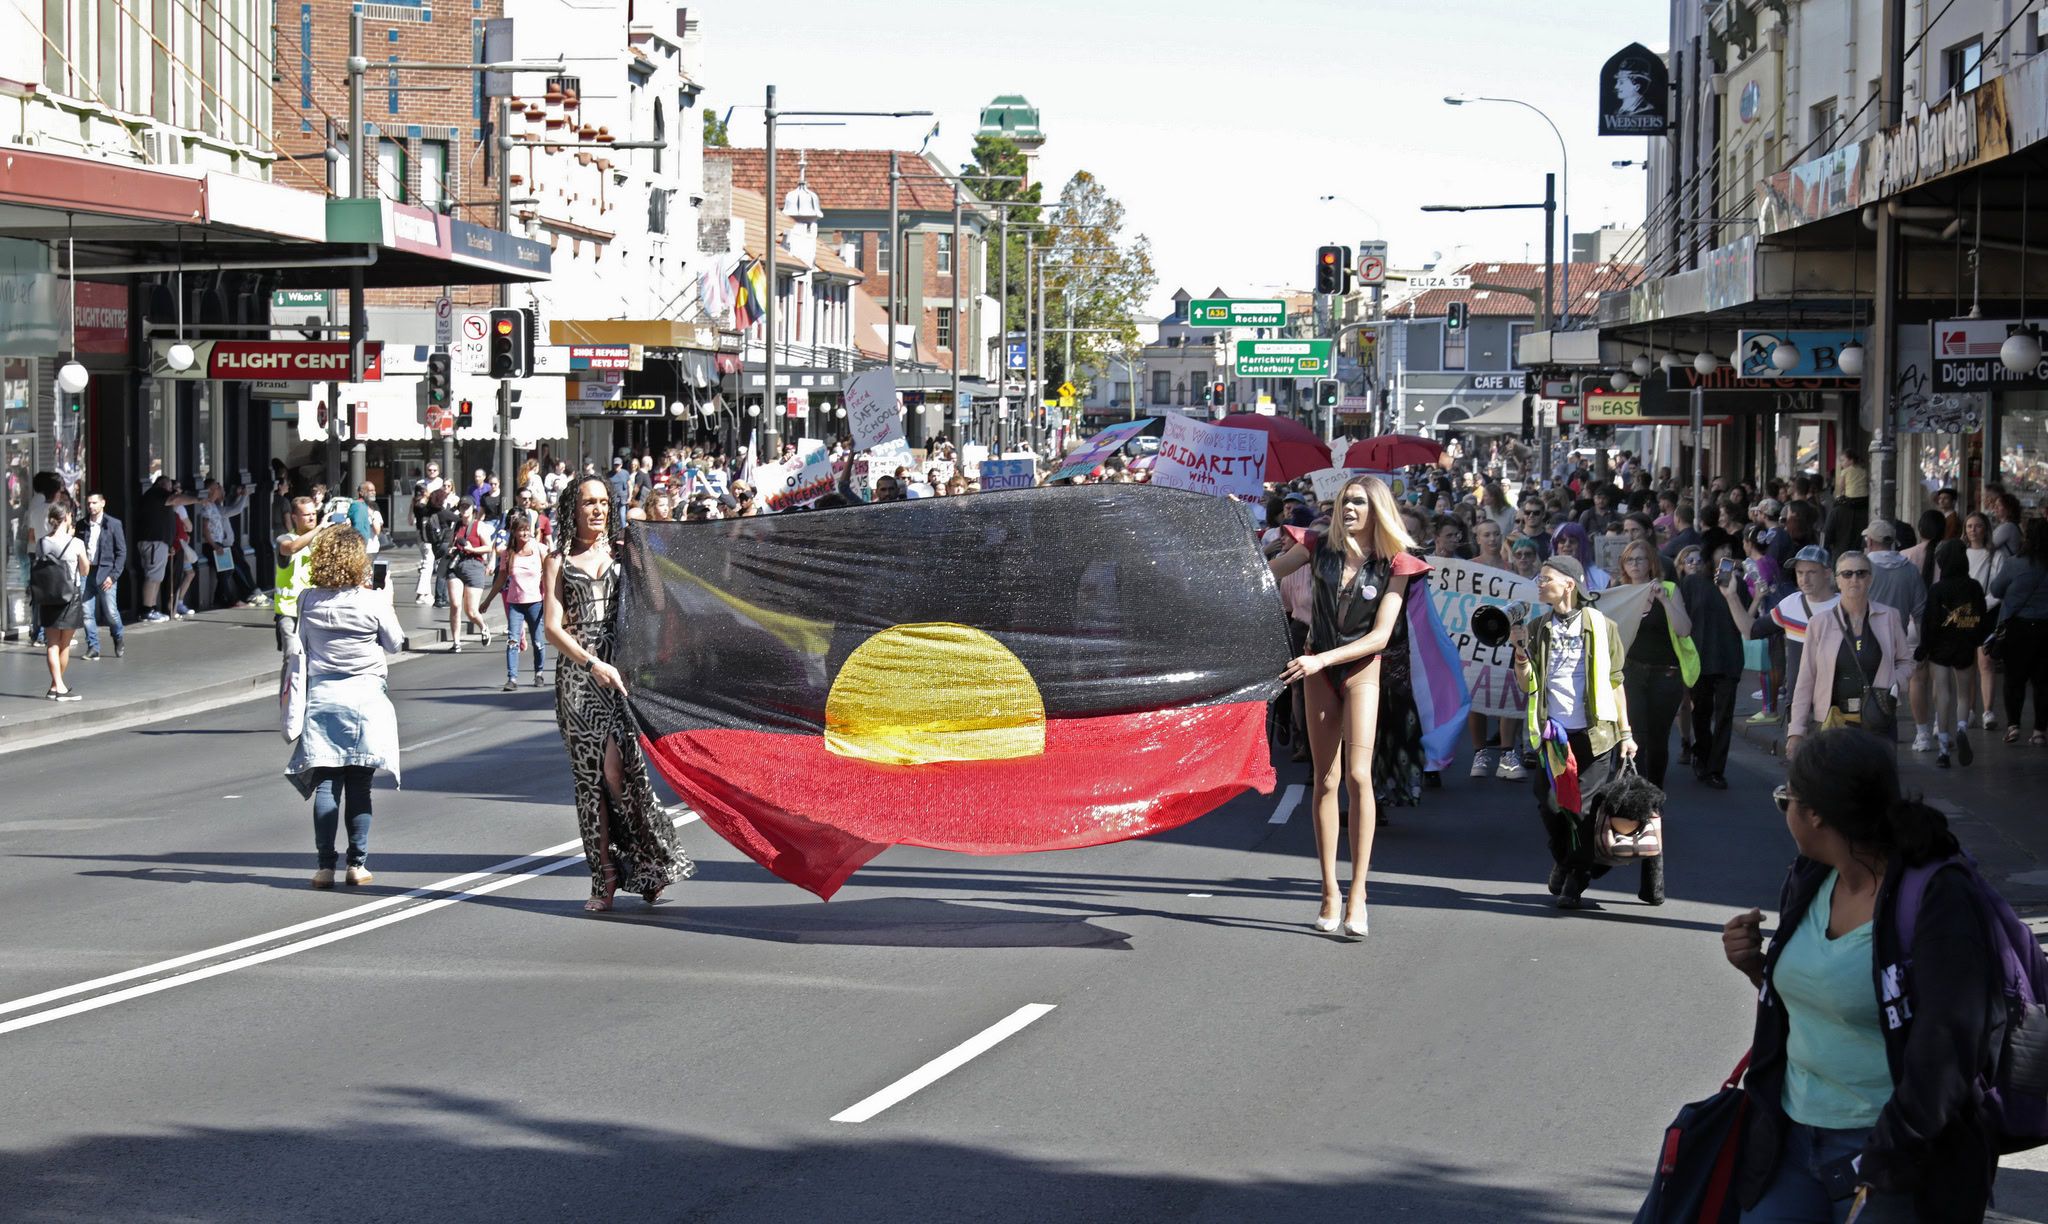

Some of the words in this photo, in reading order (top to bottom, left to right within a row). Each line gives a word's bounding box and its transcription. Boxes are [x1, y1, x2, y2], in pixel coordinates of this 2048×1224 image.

[1919, 87, 1979, 181] Garden
[1410, 277, 1447, 287] ELIZA
[1452, 277, 1467, 287] ST
[288, 291, 314, 301] Wilson
[314, 291, 322, 301] St
[75, 306, 100, 328] FLIGHT
[100, 308, 127, 329] CENTRE
[1209, 309, 1226, 317] A36
[1235, 315, 1278, 323] Rockdale
[467, 343, 483, 352] NO
[573, 348, 595, 357] SHOE
[595, 348, 629, 358] REPAIRS
[217, 352, 292, 369] FLIGHT
[294, 353, 376, 370] CENTE
[591, 359, 613, 368] KEYS
[613, 359, 630, 368] CUT
[1240, 355, 1295, 364] Marrickville
[1300, 360, 1317, 368] A34
[1241, 365, 1294, 374] Canterbury
[1942, 362, 1989, 387] Digital
[1474, 376, 1503, 389] CAFE
[603, 400, 656, 410] WORLD
[851, 391, 871, 409] need
[853, 400, 881, 427] SAFE
[858, 405, 899, 439] SCHOOLS
[1192, 426, 1259, 452] WORKER
[805, 449, 826, 467] DAY
[1159, 440, 1265, 480] SOLIDARITY
[984, 459, 1023, 476] IT'S
[786, 472, 803, 487] OF
[982, 474, 1034, 490] IDENTITY
[1189, 470, 1216, 485] with
[1316, 470, 1349, 490] Trans
[767, 480, 836, 511] VENGEANCE
[1427, 567, 1524, 600] ESPECT
